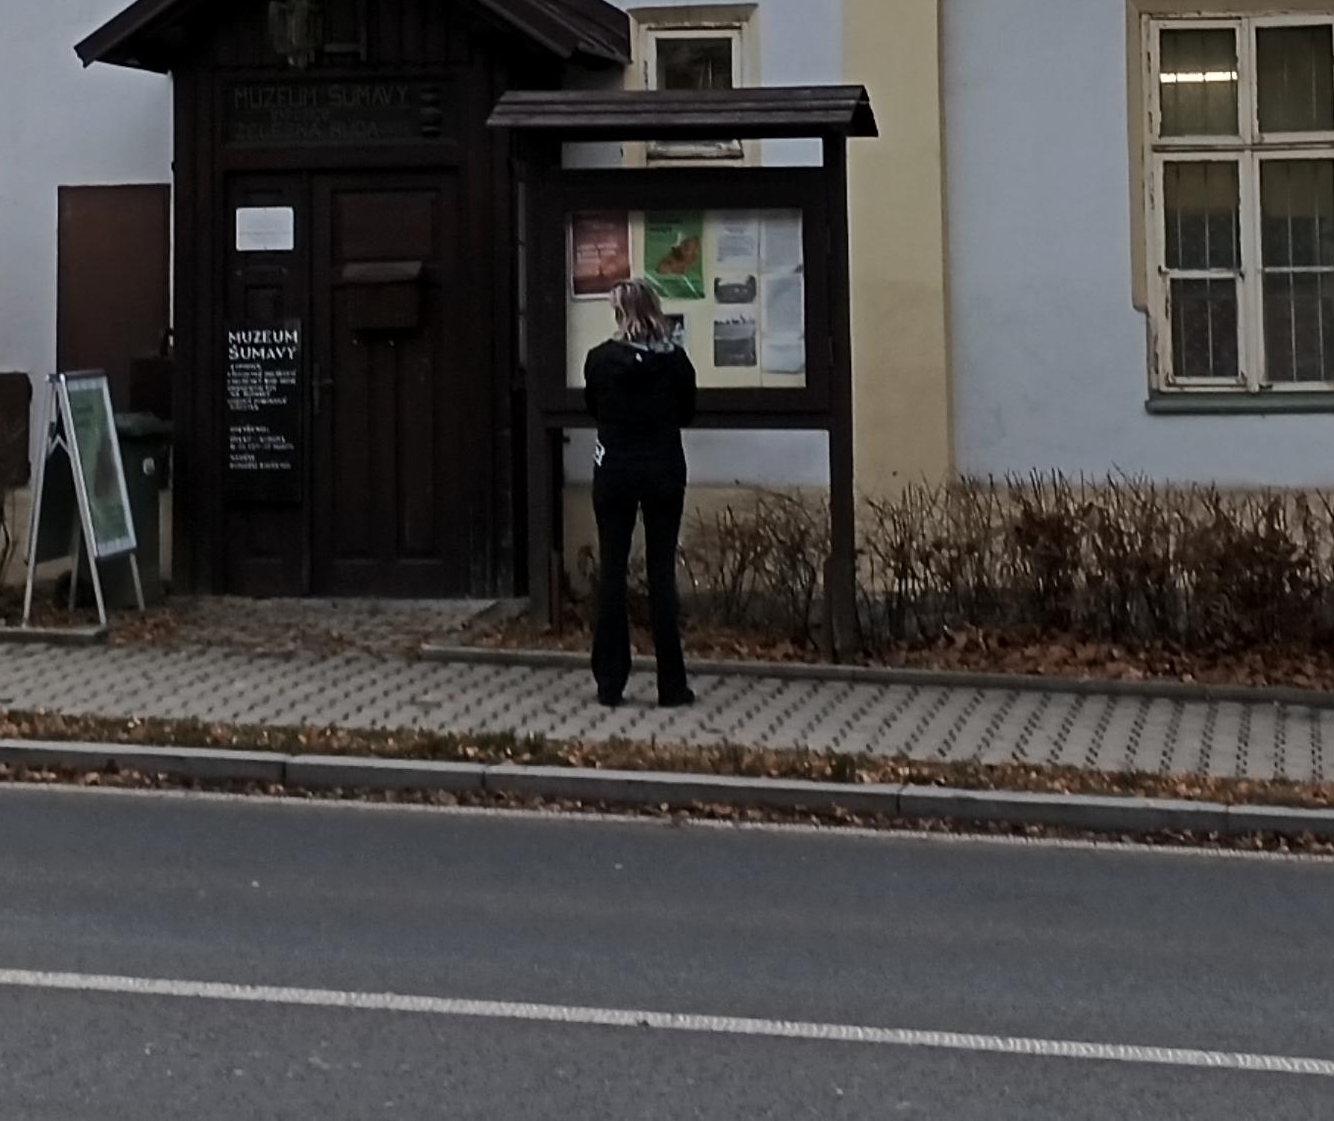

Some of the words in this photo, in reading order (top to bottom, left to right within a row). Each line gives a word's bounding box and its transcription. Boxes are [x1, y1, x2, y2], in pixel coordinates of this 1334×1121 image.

[234, 84, 316, 109] MUZEUM
[228, 330, 298, 344] MUZEUM
[228, 344, 297, 360] ŠUMAVY
